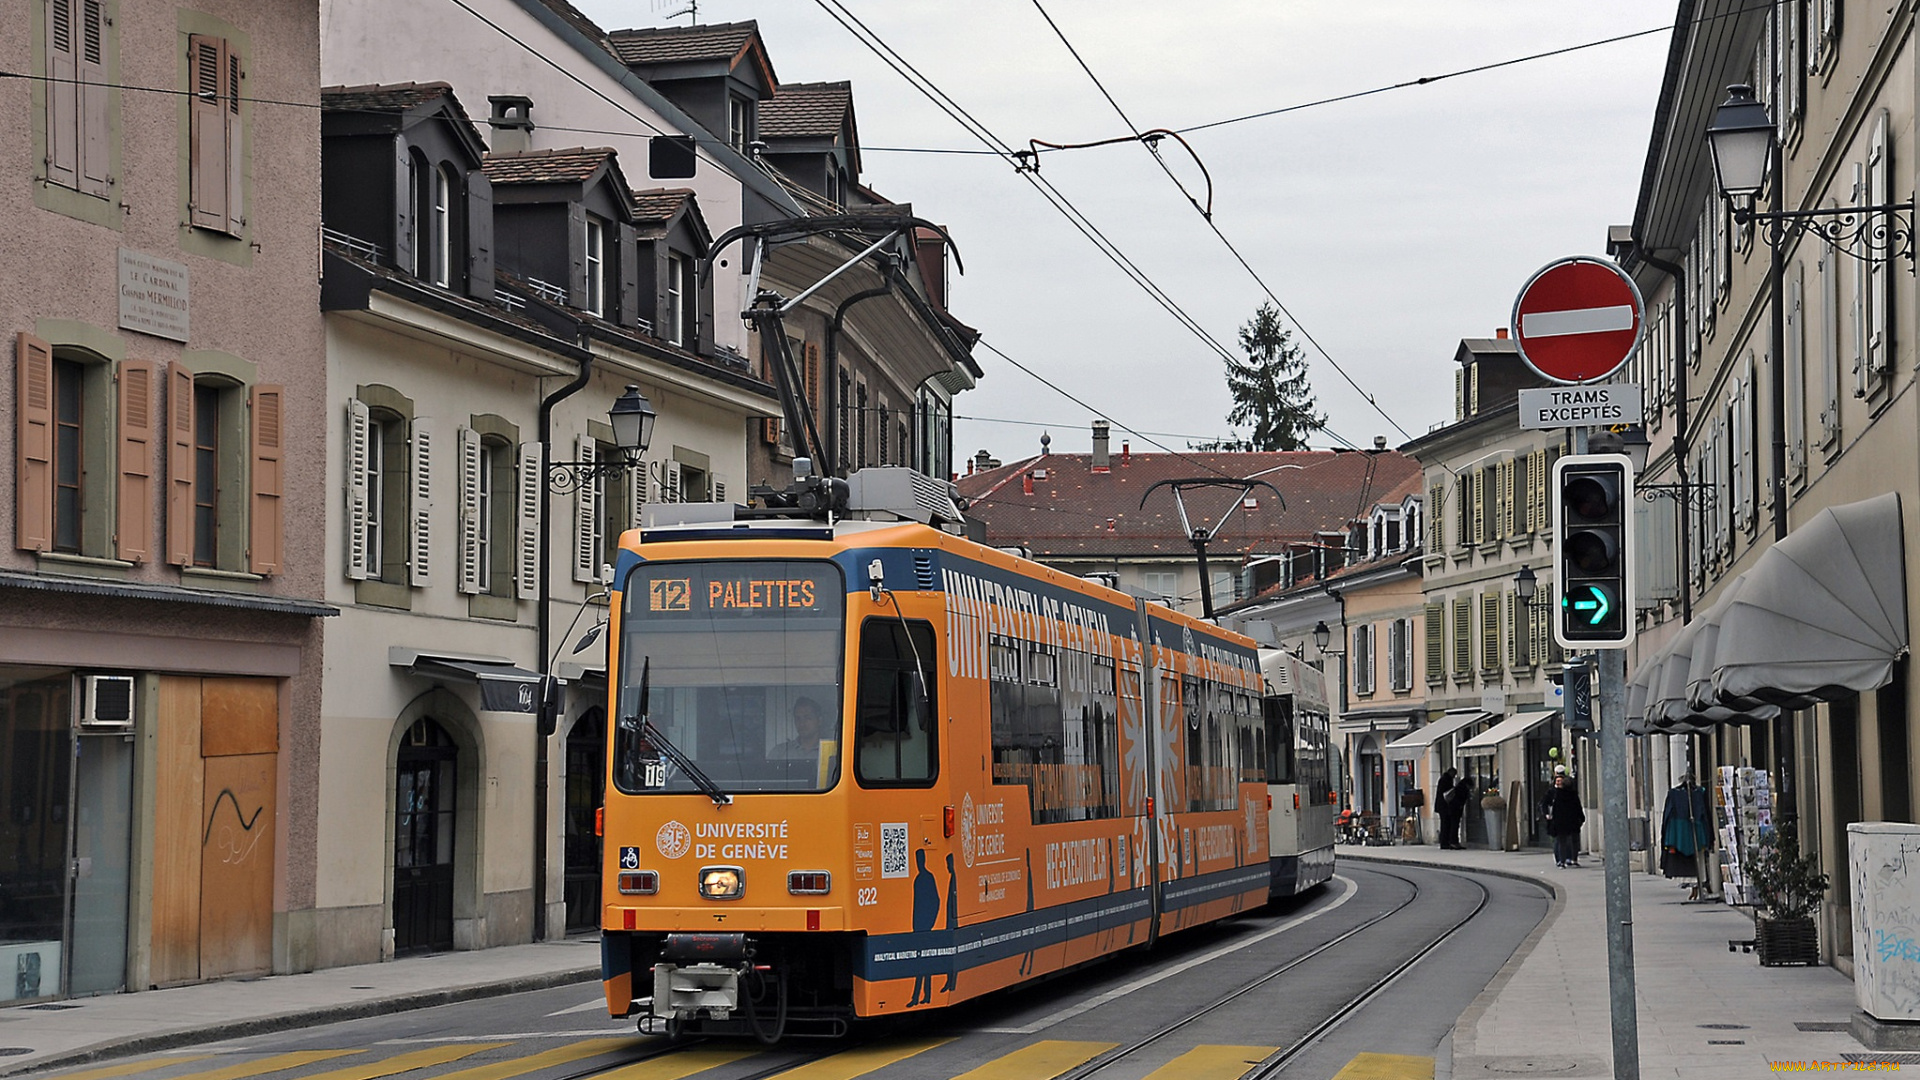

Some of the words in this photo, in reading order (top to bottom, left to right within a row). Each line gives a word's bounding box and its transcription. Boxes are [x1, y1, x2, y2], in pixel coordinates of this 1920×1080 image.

[1551, 390, 1609, 405] TRAMS
[1539, 403, 1622, 422] EXCEPTÉS
[652, 580, 688, 611] 12
[709, 580, 816, 608] PALETTES
[648, 769, 664, 783] 19
[695, 820, 788, 838] UNIVERSITÉ
[695, 844, 716, 859] DE
[722, 841, 788, 859] GENÈVE
[858, 887, 877, 907] 822
